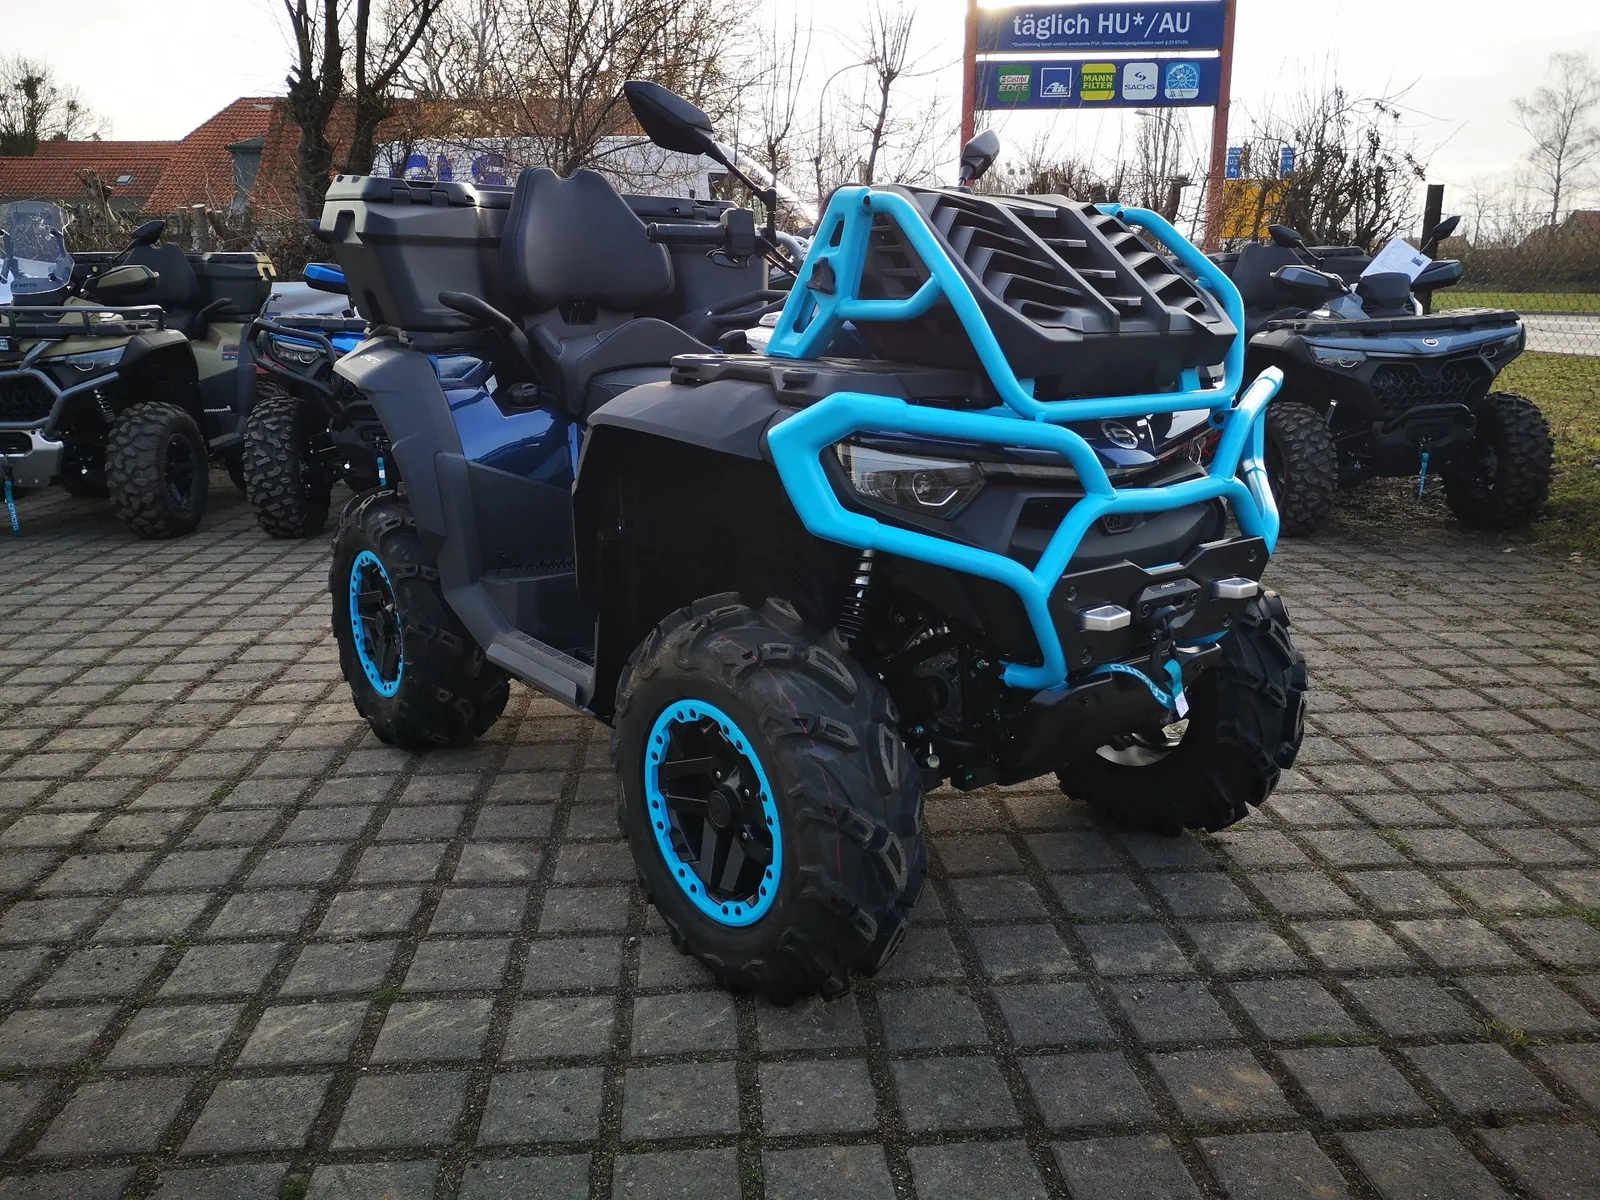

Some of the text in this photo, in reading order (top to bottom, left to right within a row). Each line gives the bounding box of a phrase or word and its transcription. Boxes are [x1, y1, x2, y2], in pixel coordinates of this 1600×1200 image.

[1013, 13, 1090, 40] täglich
[1083, 74, 1113, 82] MANN
[999, 84, 1029, 92] EDGE
[1083, 81, 1113, 89] FILTER
[1124, 83, 1156, 91] SACHS
[1110, 663, 1168, 704] CFMOTO
